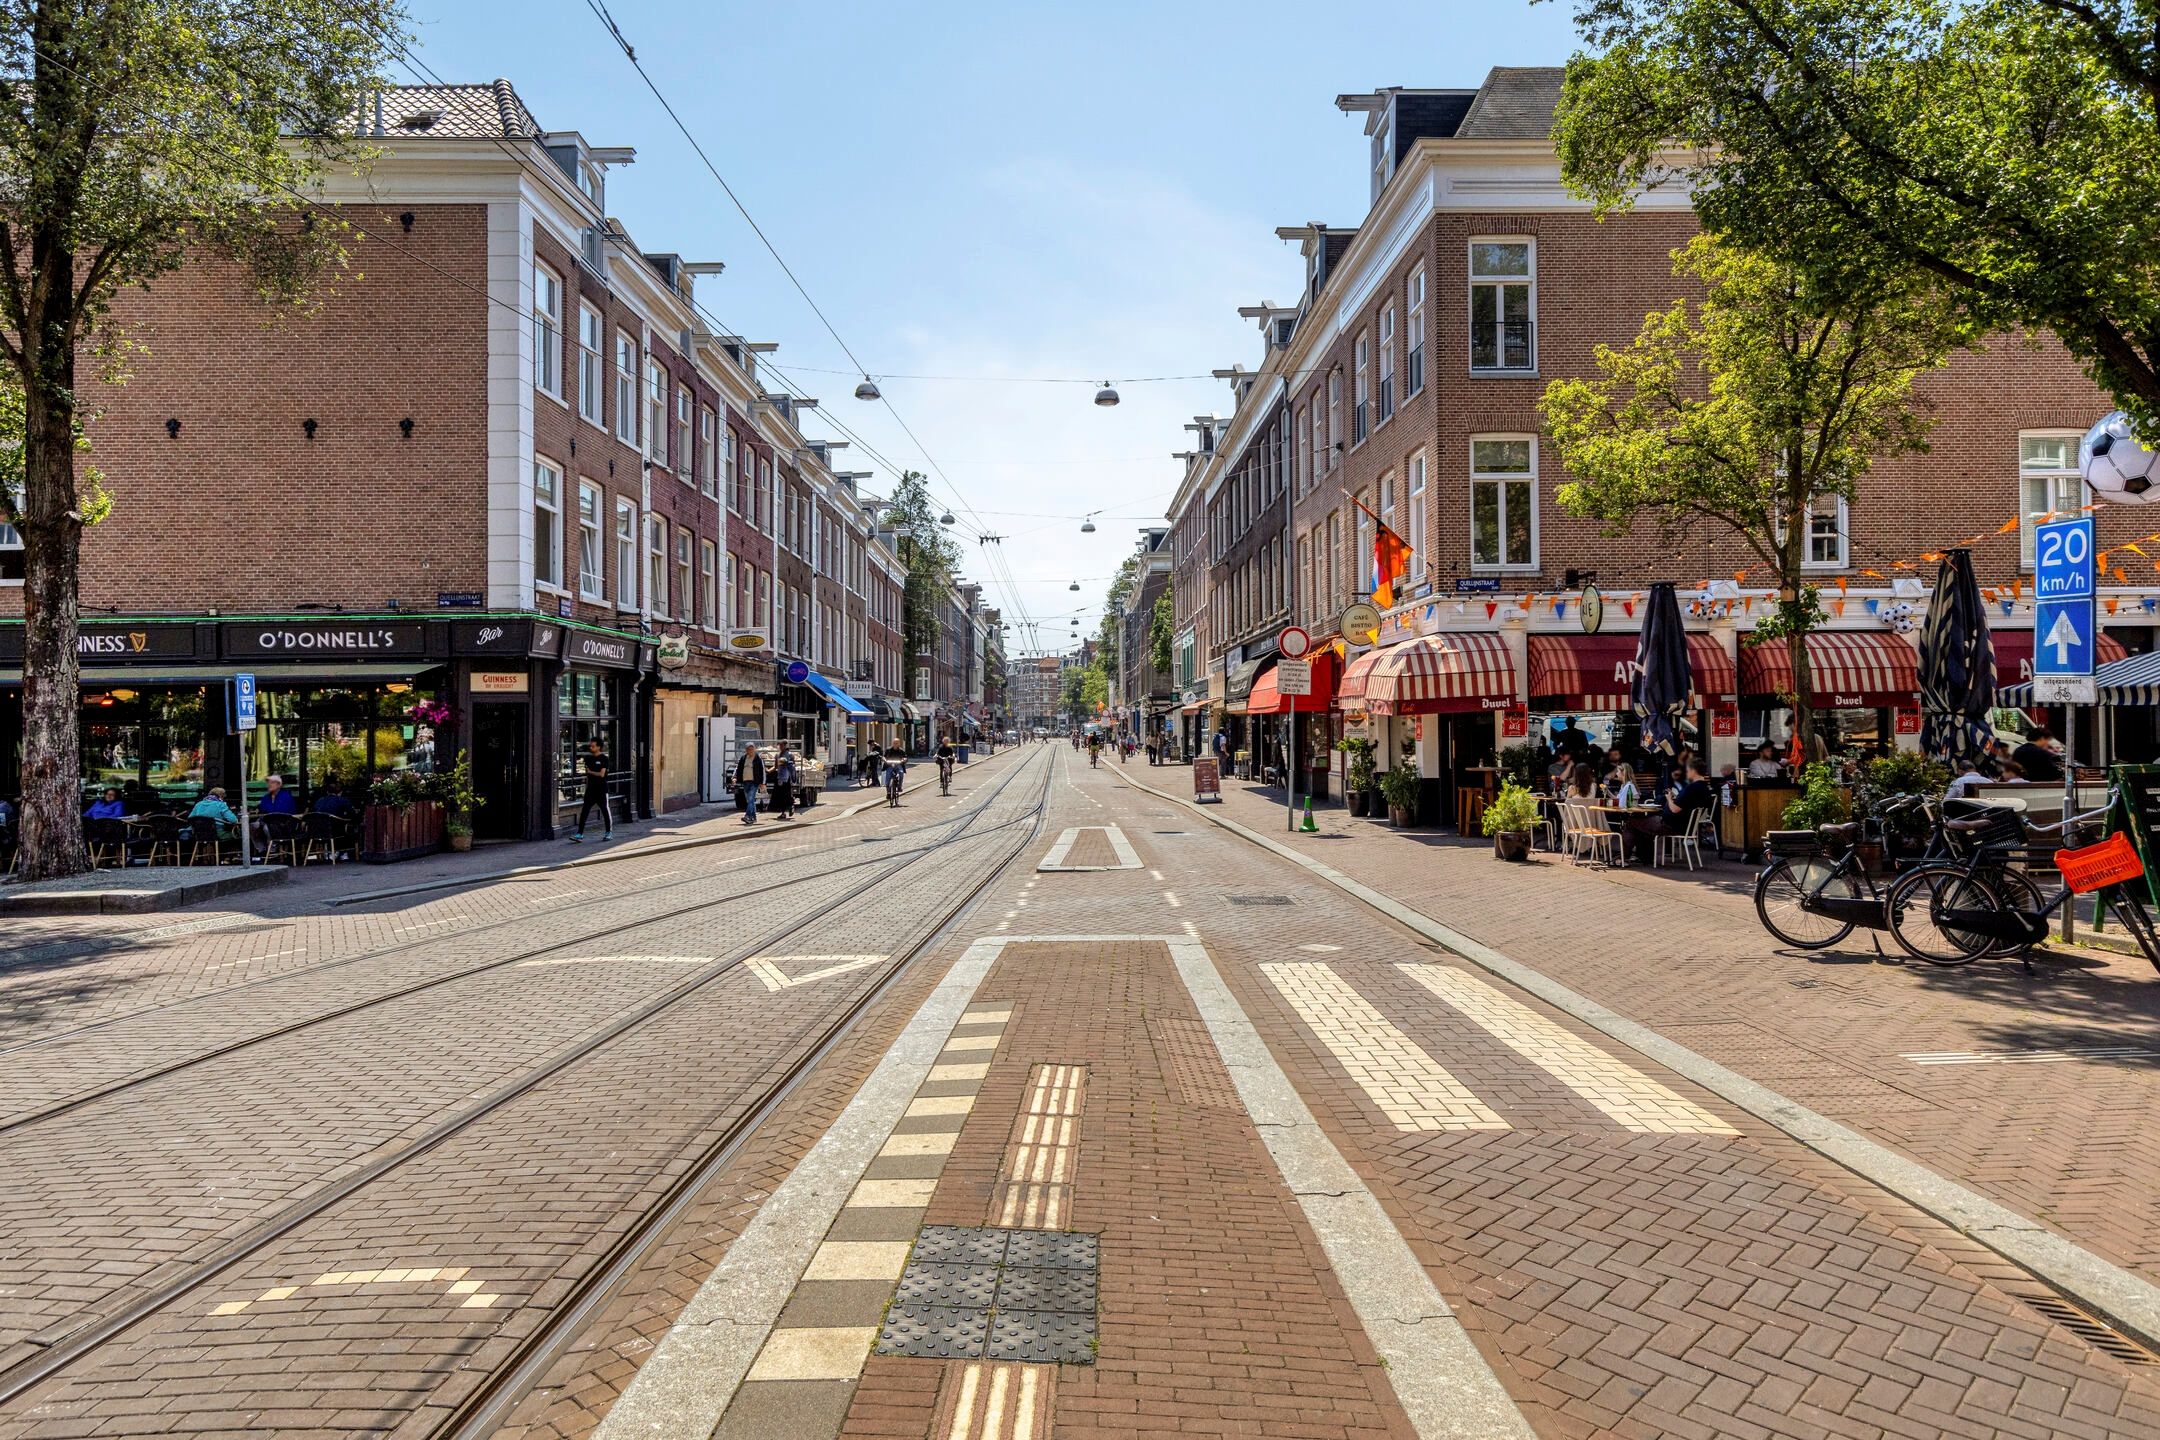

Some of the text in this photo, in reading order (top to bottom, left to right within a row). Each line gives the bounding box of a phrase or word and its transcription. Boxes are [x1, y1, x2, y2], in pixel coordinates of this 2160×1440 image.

[2041, 528, 2087, 567] 20
[2041, 571, 2084, 592] km/h
[259, 630, 394, 648] O'DONNELL'S
[477, 627, 503, 645] Bar
[583, 640, 624, 659] O'DONNELL'S
[482, 674, 517, 683] GUINNESS
[1481, 697, 1511, 708] Duvel
[1835, 695, 1863, 705] Duvel
